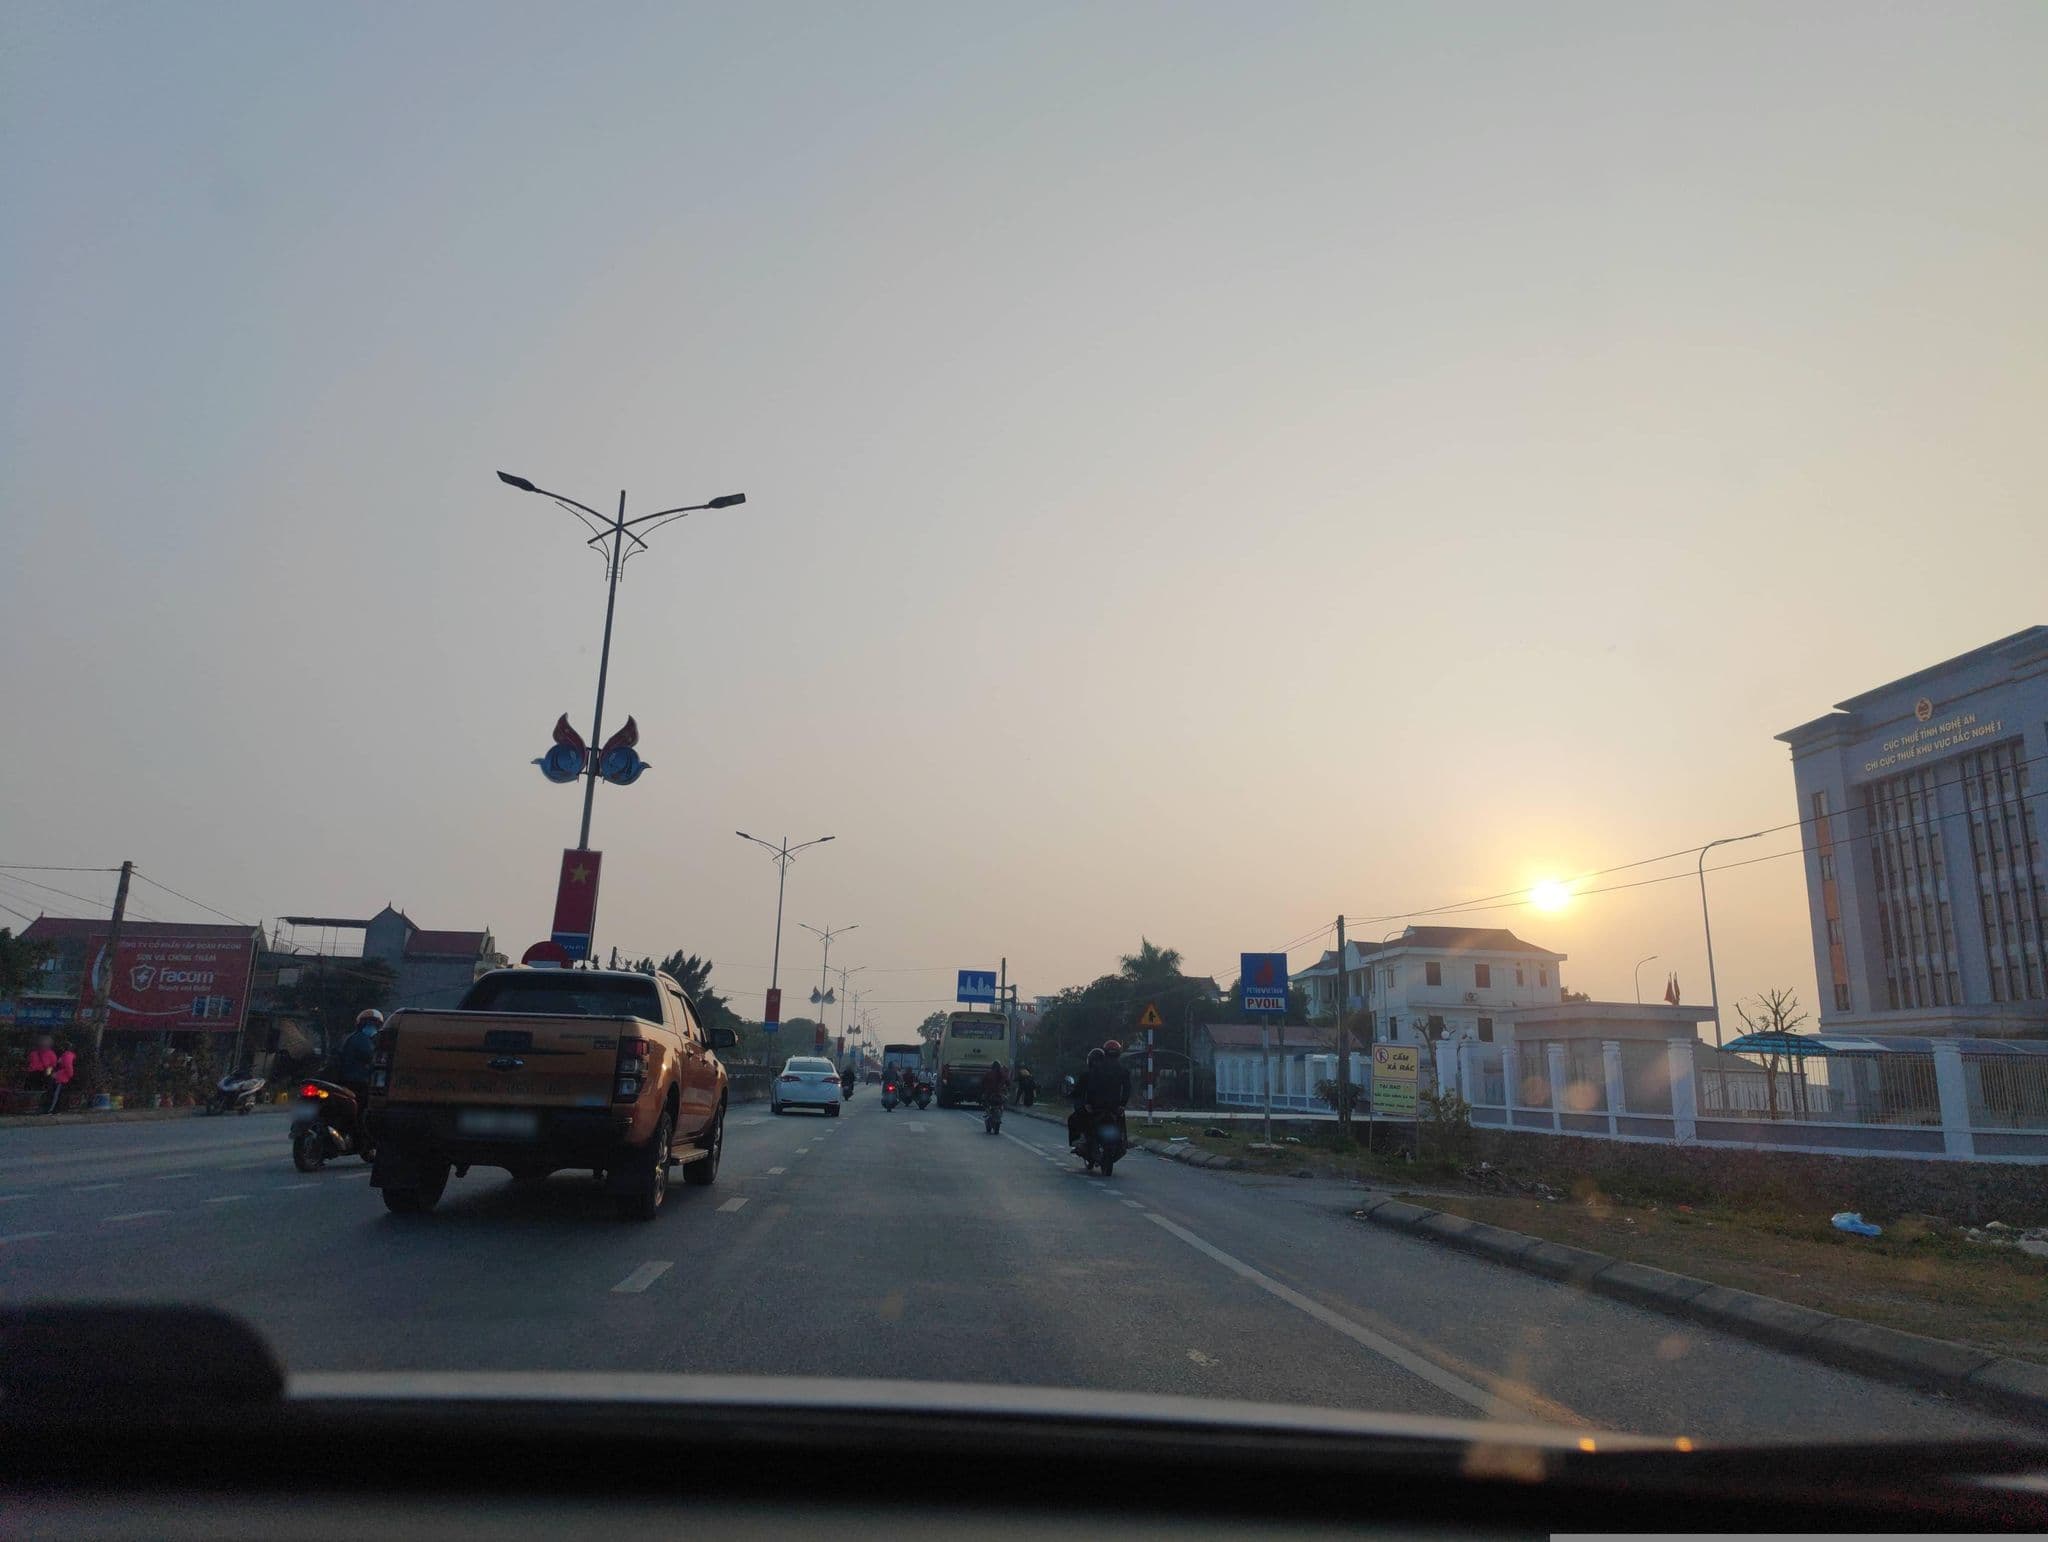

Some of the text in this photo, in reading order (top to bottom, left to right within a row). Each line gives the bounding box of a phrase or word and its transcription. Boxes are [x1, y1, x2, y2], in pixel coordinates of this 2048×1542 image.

[1901, 728, 1920, 745] THUẾ
[1963, 713, 1976, 725] AN
[1864, 761, 1879, 772] CHI
[1897, 744, 1916, 761] THUẾ
[158, 967, 214, 984] Facom
[1247, 998, 1283, 1009] PVOIL
[1392, 1052, 1409, 1061] CẤM
[1399, 1063, 1415, 1072] RÁC
